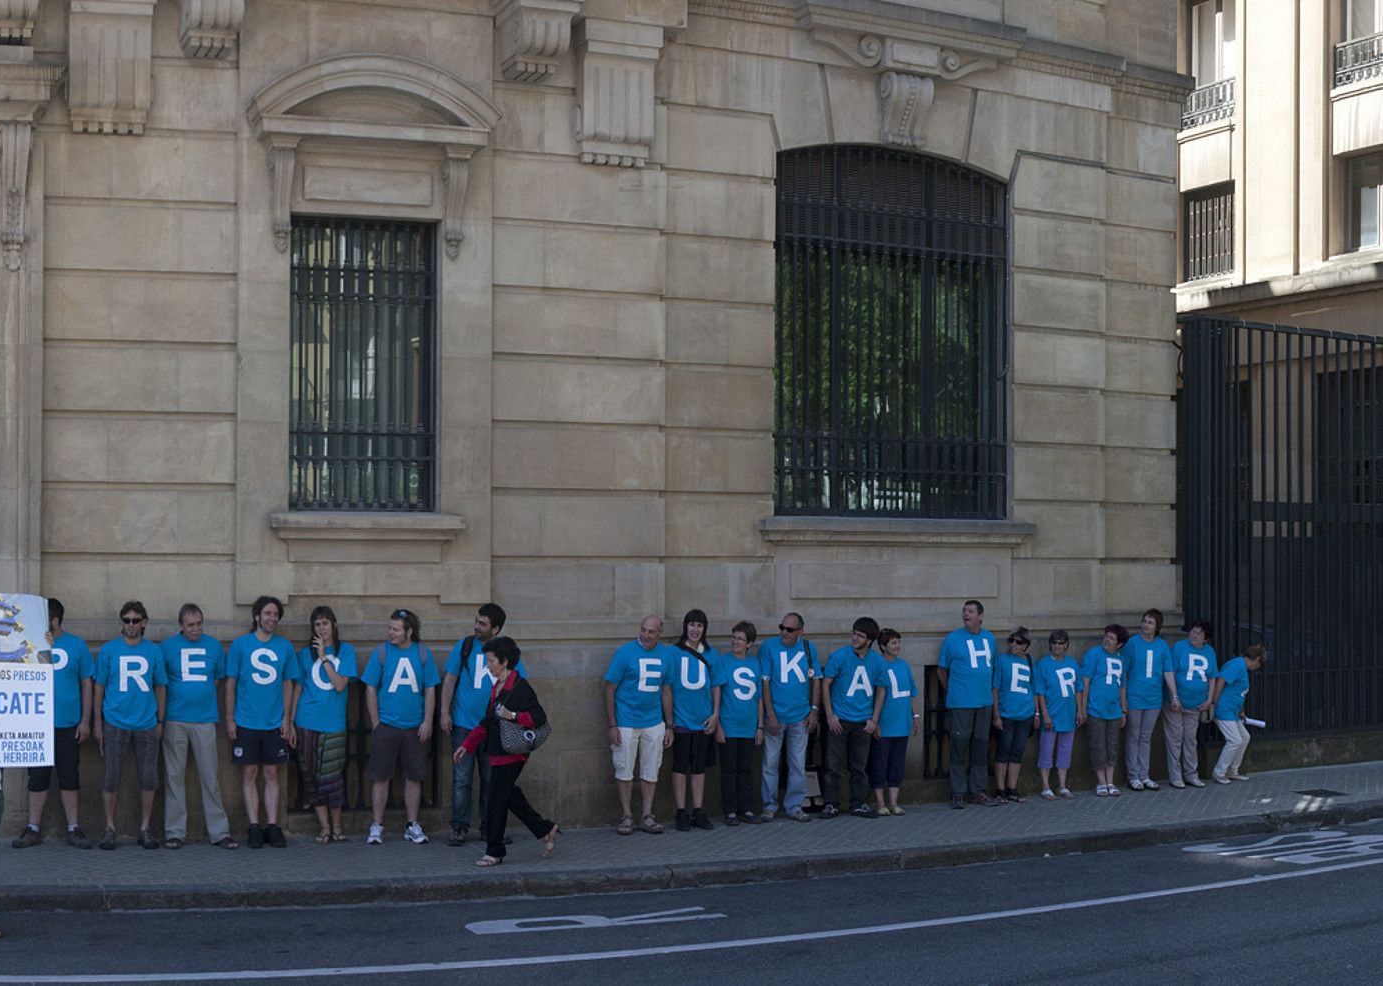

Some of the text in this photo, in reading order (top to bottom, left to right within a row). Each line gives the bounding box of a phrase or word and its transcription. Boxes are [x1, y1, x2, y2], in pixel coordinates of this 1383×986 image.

[181, 648, 207, 681] E
[251, 648, 278, 684] S
[780, 651, 806, 683] K
[967, 639, 991, 668] H
[1147, 650, 1153, 677] I
[1186, 653, 1209, 682] R
[13, 670, 47, 681] PRESOS
[120, 656, 149, 691] R
[388, 657, 418, 692] A
[638, 658, 661, 692] E
[681, 657, 706, 689] U
[732, 666, 756, 700] S
[847, 666, 873, 696] A
[888, 668, 911, 699] L
[1011, 663, 1030, 693] E
[1056, 668, 1076, 698] R
[1106, 658, 1122, 687] R
[1, 740, 45, 752] PRESOAK
[3, 752, 45, 763] HERRIRA
